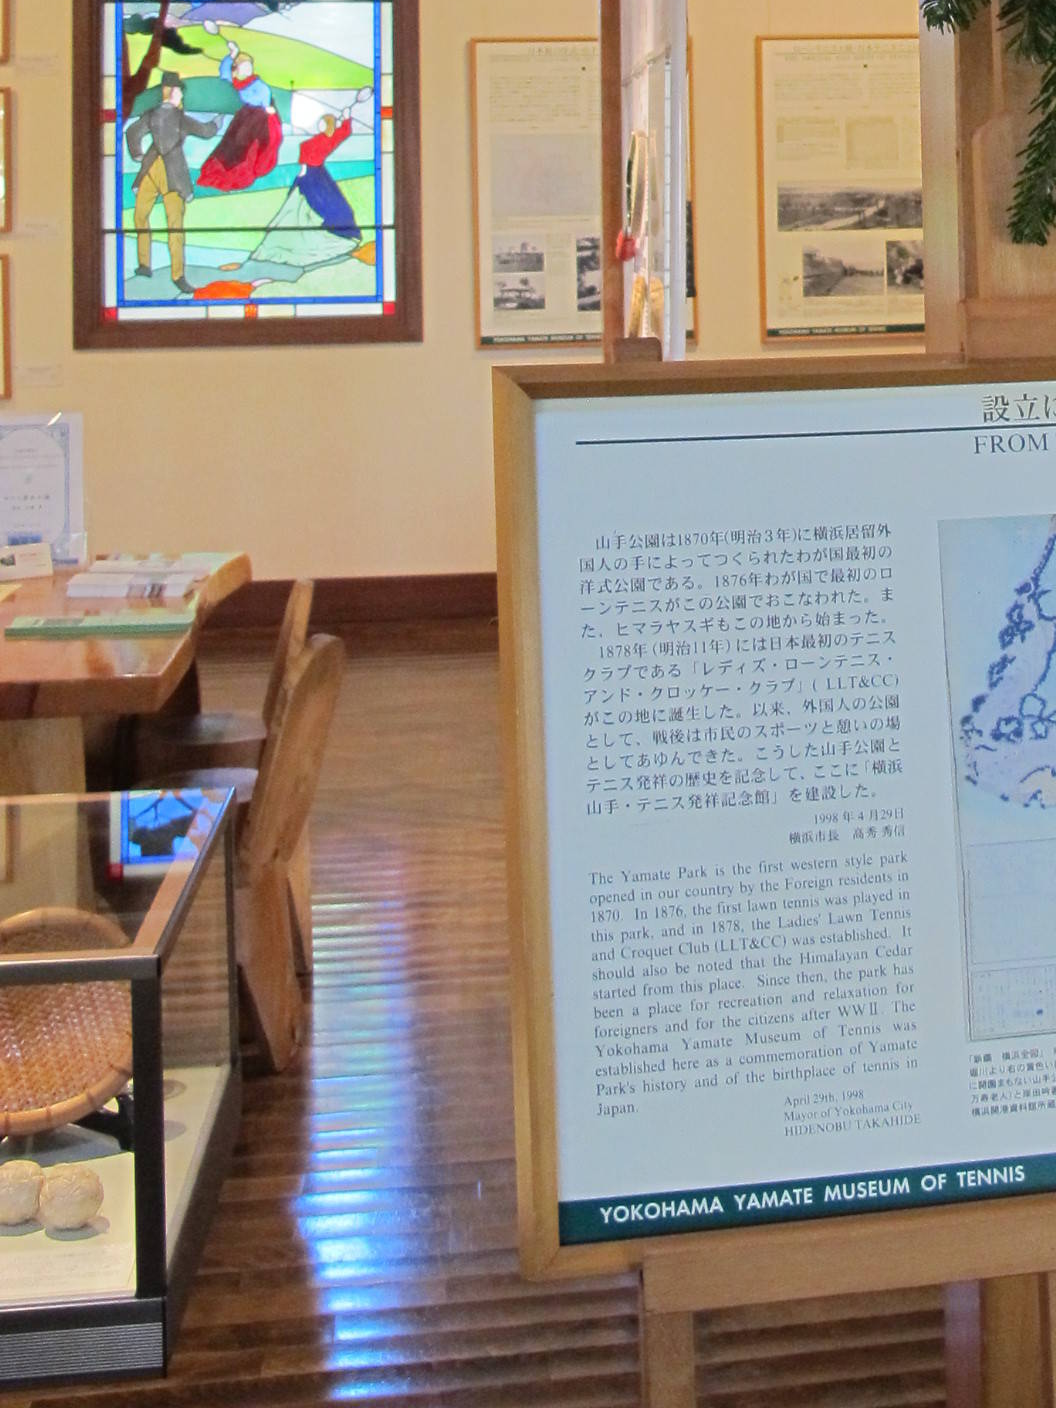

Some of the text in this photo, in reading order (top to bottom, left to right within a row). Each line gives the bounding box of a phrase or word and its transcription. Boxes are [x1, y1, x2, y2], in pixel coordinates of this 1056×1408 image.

[973, 432, 1049, 455] FROM
[579, 544, 892, 573] 国人の手によってつくられたわが国最初の
[579, 566, 892, 595] 洋式公園である。1876年わが国で最初のロ
[585, 714, 901, 749] として、戦後は市民のスポーツと憩いの場
[586, 736, 900, 771] としてあゆんできた。こうした山手公園と
[588, 850, 908, 886] The Yamate Park is the first western style park
[588, 871, 909, 907] opened in our country by the Foreign residents in
[591, 887, 910, 923] 1870. In 1876, the first lawn tennis was played in
[590, 908, 911, 945] this park, and in 1878, the Ladies' Lawn Tennis
[591, 924, 912, 962] and Croquet Club (LLT&CC) was established. It
[591, 943, 913, 982] should also be noted that the Himalayan Cedar
[592, 962, 914, 1000] started from this place. Since then, the park has
[593, 981, 914, 1020] been a place for recreation and relaxation for
[593, 1023, 658, 1040] foreigners
[664, 1017, 689, 1034] and
[695, 1016, 715, 1031] for
[721, 1014, 742, 1028] the
[747, 1011, 795, 1026] citizens
[800, 1007, 831, 1022] after
[891, 999, 916, 1013] The
[594, 1021, 917, 1058] Yokohama Yamate Museum of Tennis was
[594, 1039, 917, 1078] established here as a commemoration of Yamate
[596, 1056, 918, 1097] Park's history and of the birthplace of tennis in
[596, 1102, 638, 1118] Japan.
[783, 1101, 913, 1122] Mayor of Yokohama City
[784, 1094, 810, 1108] April
[841, 1089, 864, 1101] 1998
[784, 1113, 920, 1137] HIDENOBU TAKAHIDE
[600, 1165, 1025, 1223] YOKOHAMA YAMATE MUSEUM OF TENNIS
